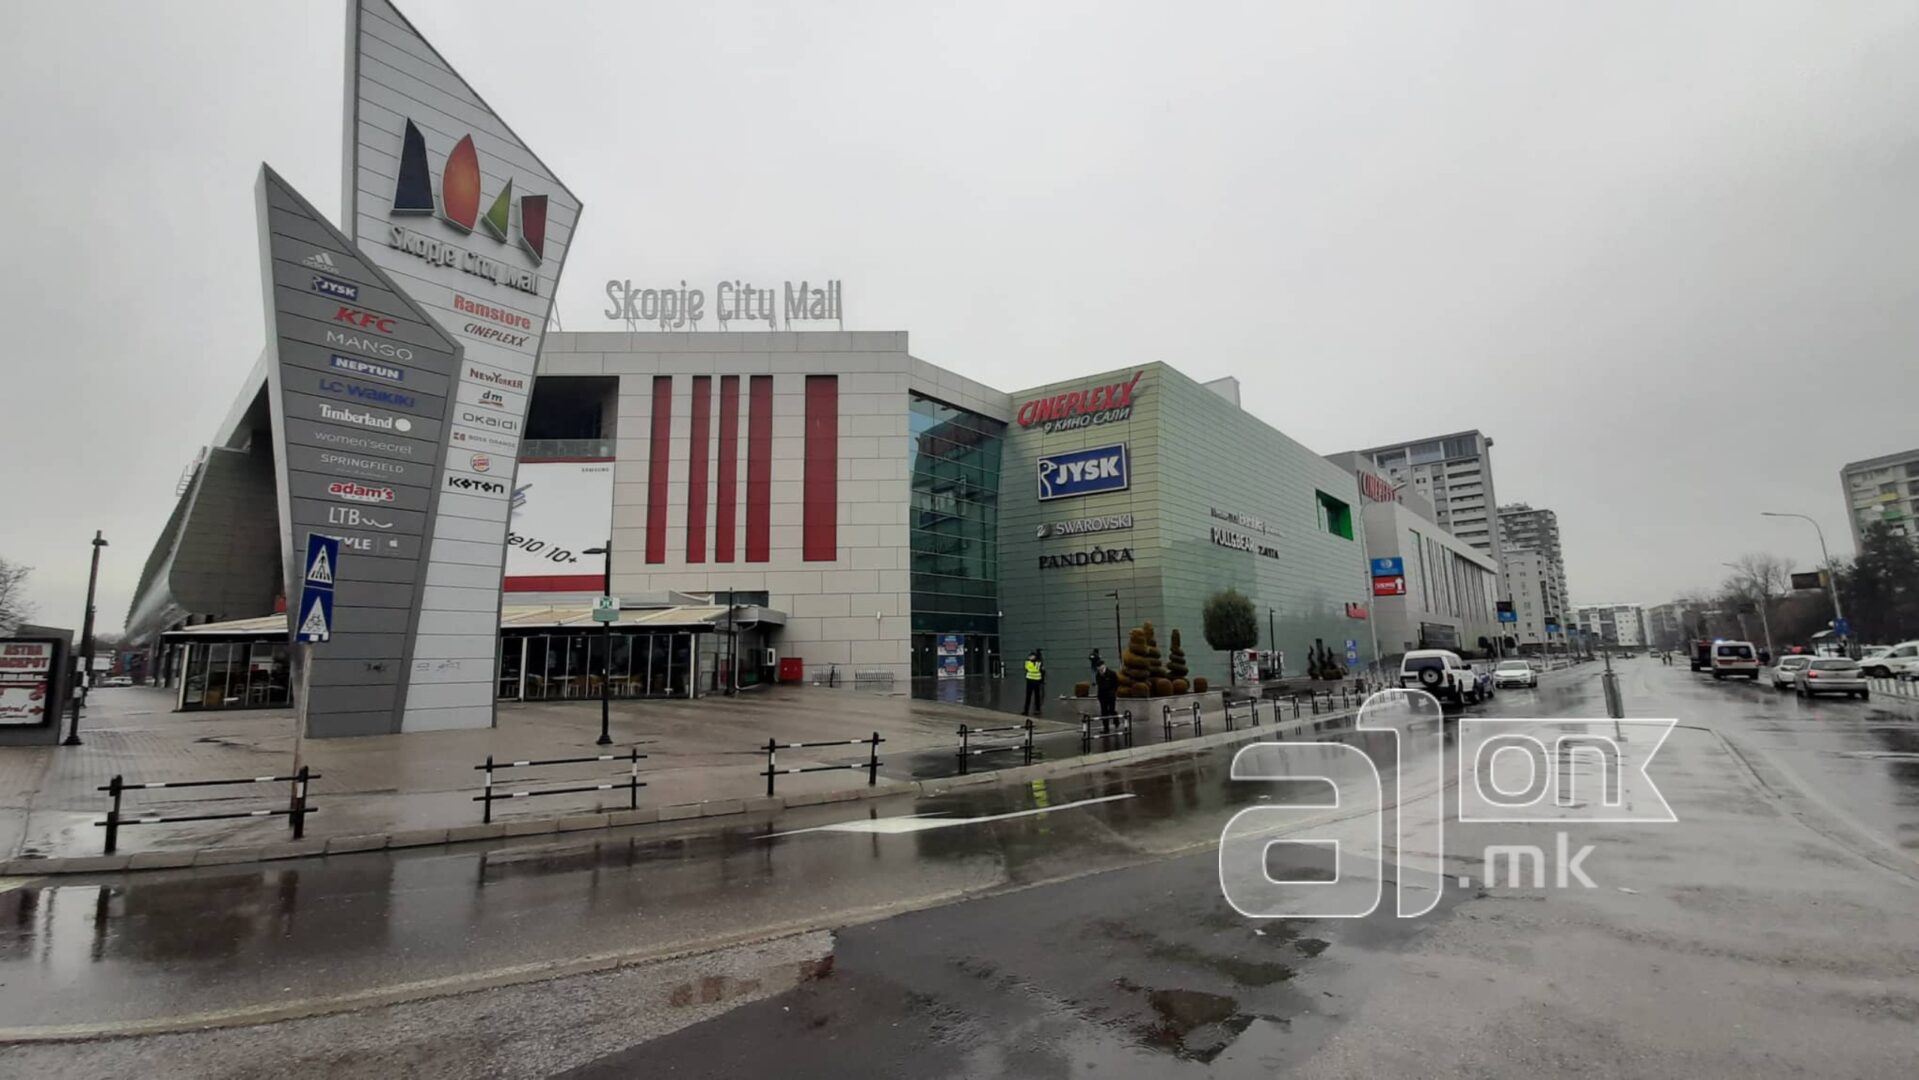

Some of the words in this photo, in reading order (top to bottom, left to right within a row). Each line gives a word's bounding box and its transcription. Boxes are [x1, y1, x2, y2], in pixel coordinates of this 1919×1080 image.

[390, 226, 456, 267] Skopje
[463, 251, 498, 285] City
[506, 266, 539, 296] Mall
[321, 281, 356, 297] JYSK
[454, 293, 532, 330] Ramstore
[604, 280, 705, 328] Skopje
[717, 280, 777, 328] City
[784, 280, 842, 320] Mall
[334, 306, 397, 334] KFC
[326, 330, 413, 360] MANGO
[464, 323, 530, 347] CINEPLEXX
[335, 357, 399, 379] NEPTUN
[319, 379, 344, 393] LC
[482, 390, 503, 402] dm
[1017, 370, 1144, 427] CINEPLEXX
[320, 404, 393, 429] Timberland
[1044, 422, 1053, 434] 9
[1055, 414, 1090, 432] КИНО
[1093, 407, 1130, 424] САЛИ
[321, 453, 404, 474] SPRINGFIELD
[1055, 456, 1120, 485] JYSK
[329, 482, 394, 501] adam's
[328, 506, 360, 525] LTB
[1055, 513, 1132, 535] SWAROVSKI
[1038, 547, 1134, 569] PANDORA
